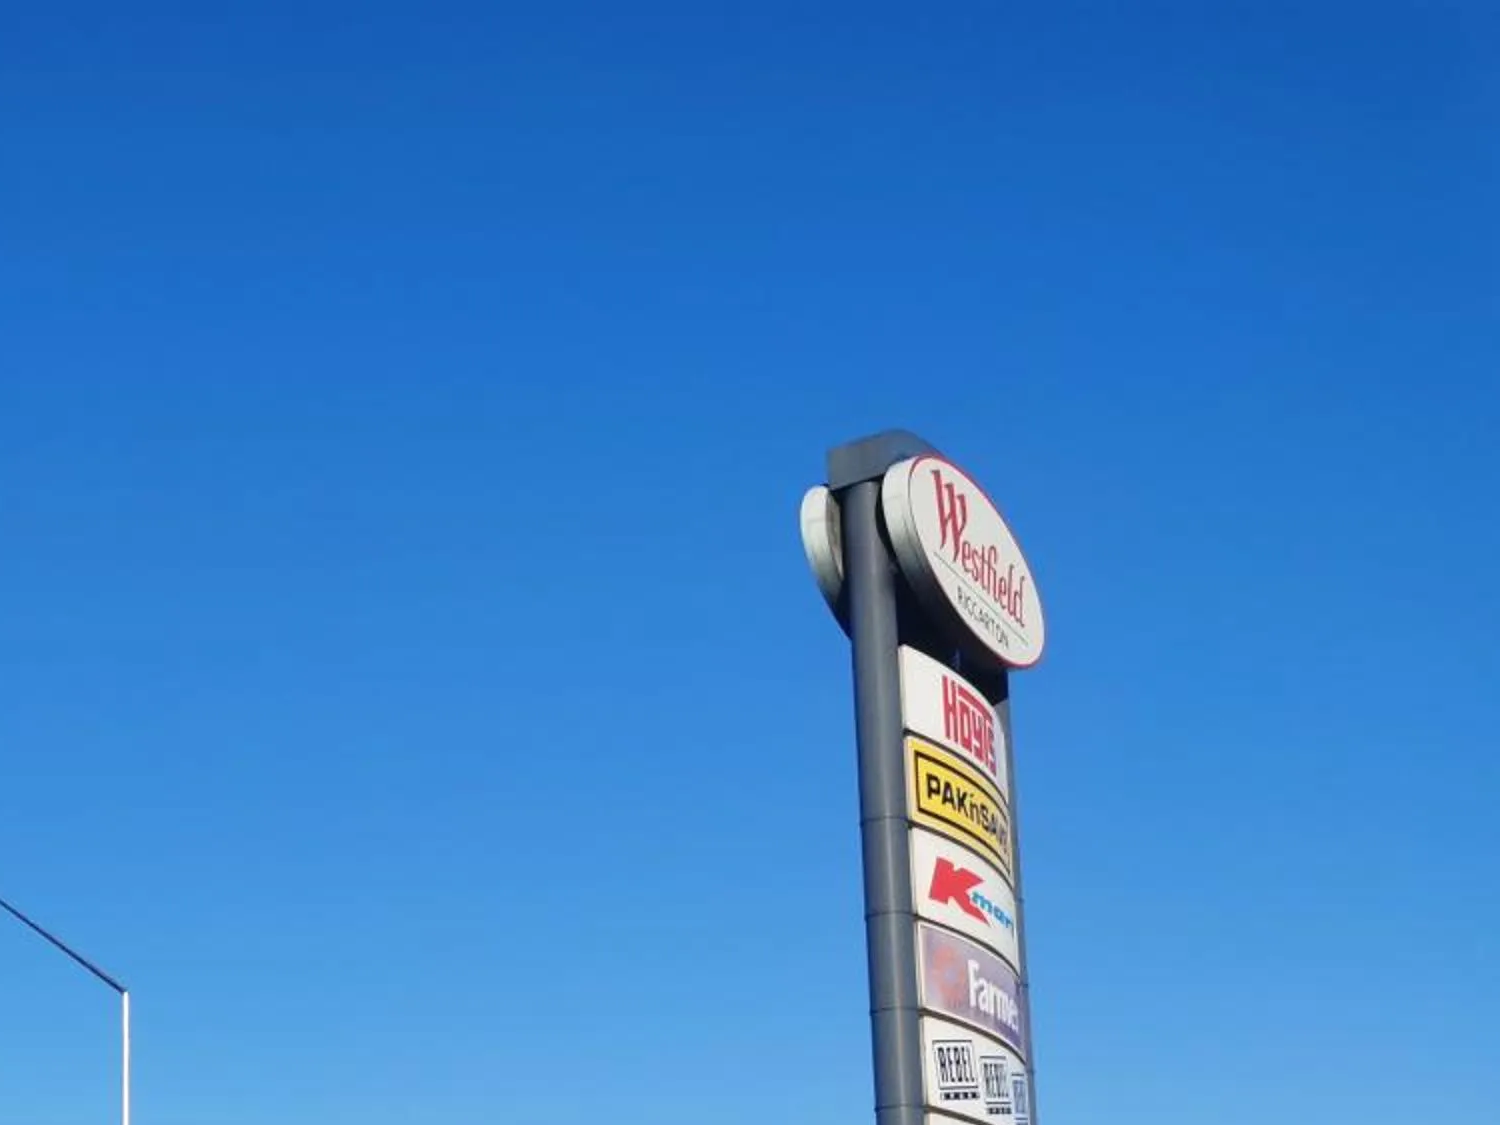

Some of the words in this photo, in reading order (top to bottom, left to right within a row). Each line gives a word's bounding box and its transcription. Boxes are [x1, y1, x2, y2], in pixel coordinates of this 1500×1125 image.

[932, 469, 1026, 628] Westfield
[926, 774, 1008, 855] PAK'nSA
[929, 855, 1014, 931] Kmar
[967, 959, 1020, 1033] Farme
[938, 1047, 975, 1083] REBEL
